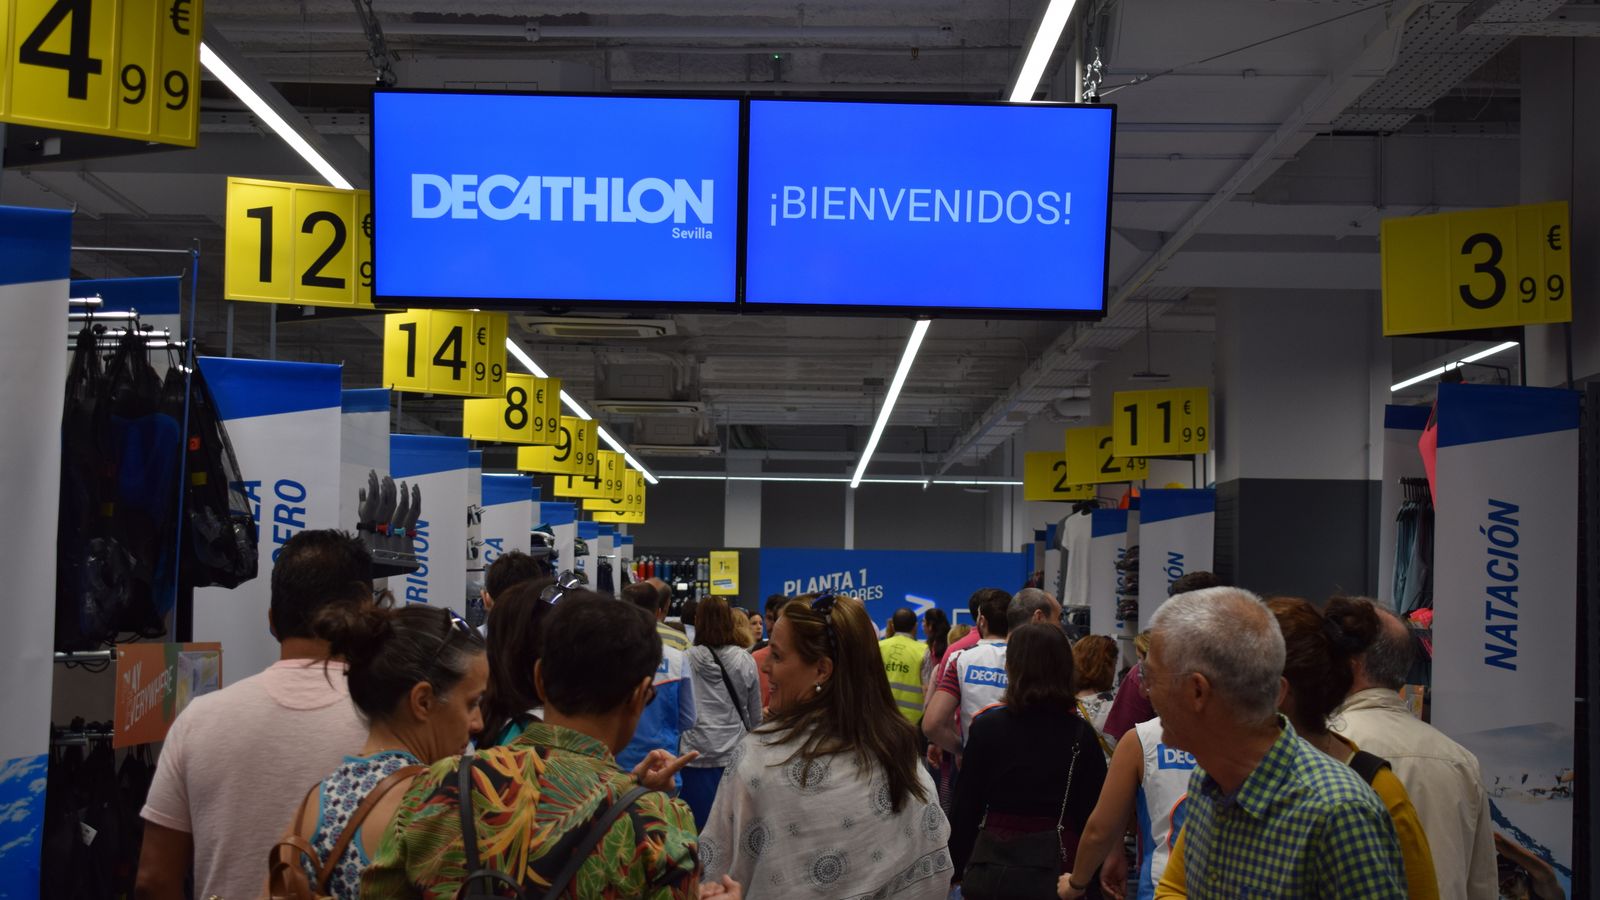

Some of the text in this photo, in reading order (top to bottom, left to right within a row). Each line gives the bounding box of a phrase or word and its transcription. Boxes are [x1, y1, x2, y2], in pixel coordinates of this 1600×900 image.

[19, 0, 103, 100] 4
[121, 64, 189, 111] 99
[412, 174, 714, 225] DECATHLON
[770, 186, 1072, 226] ¡BIENVENIDOS!
[247, 205, 347, 290] 12
[672, 228, 713, 240] Sevilla
[1458, 224, 1565, 310] 3 € 99
[399, 322, 503, 383] 14 € 99
[504, 386, 528, 430] 8
[534, 416, 558, 434] 99
[1123, 400, 1206, 446] 11 € 99
[553, 426, 573, 462] 9
[575, 452, 595, 466] 99
[1098, 436, 1122, 474] 2
[1052, 460, 1072, 493] 2
[783, 568, 867, 597] PLANTA 1
[1479, 498, 1521, 672] NATACIÓN
